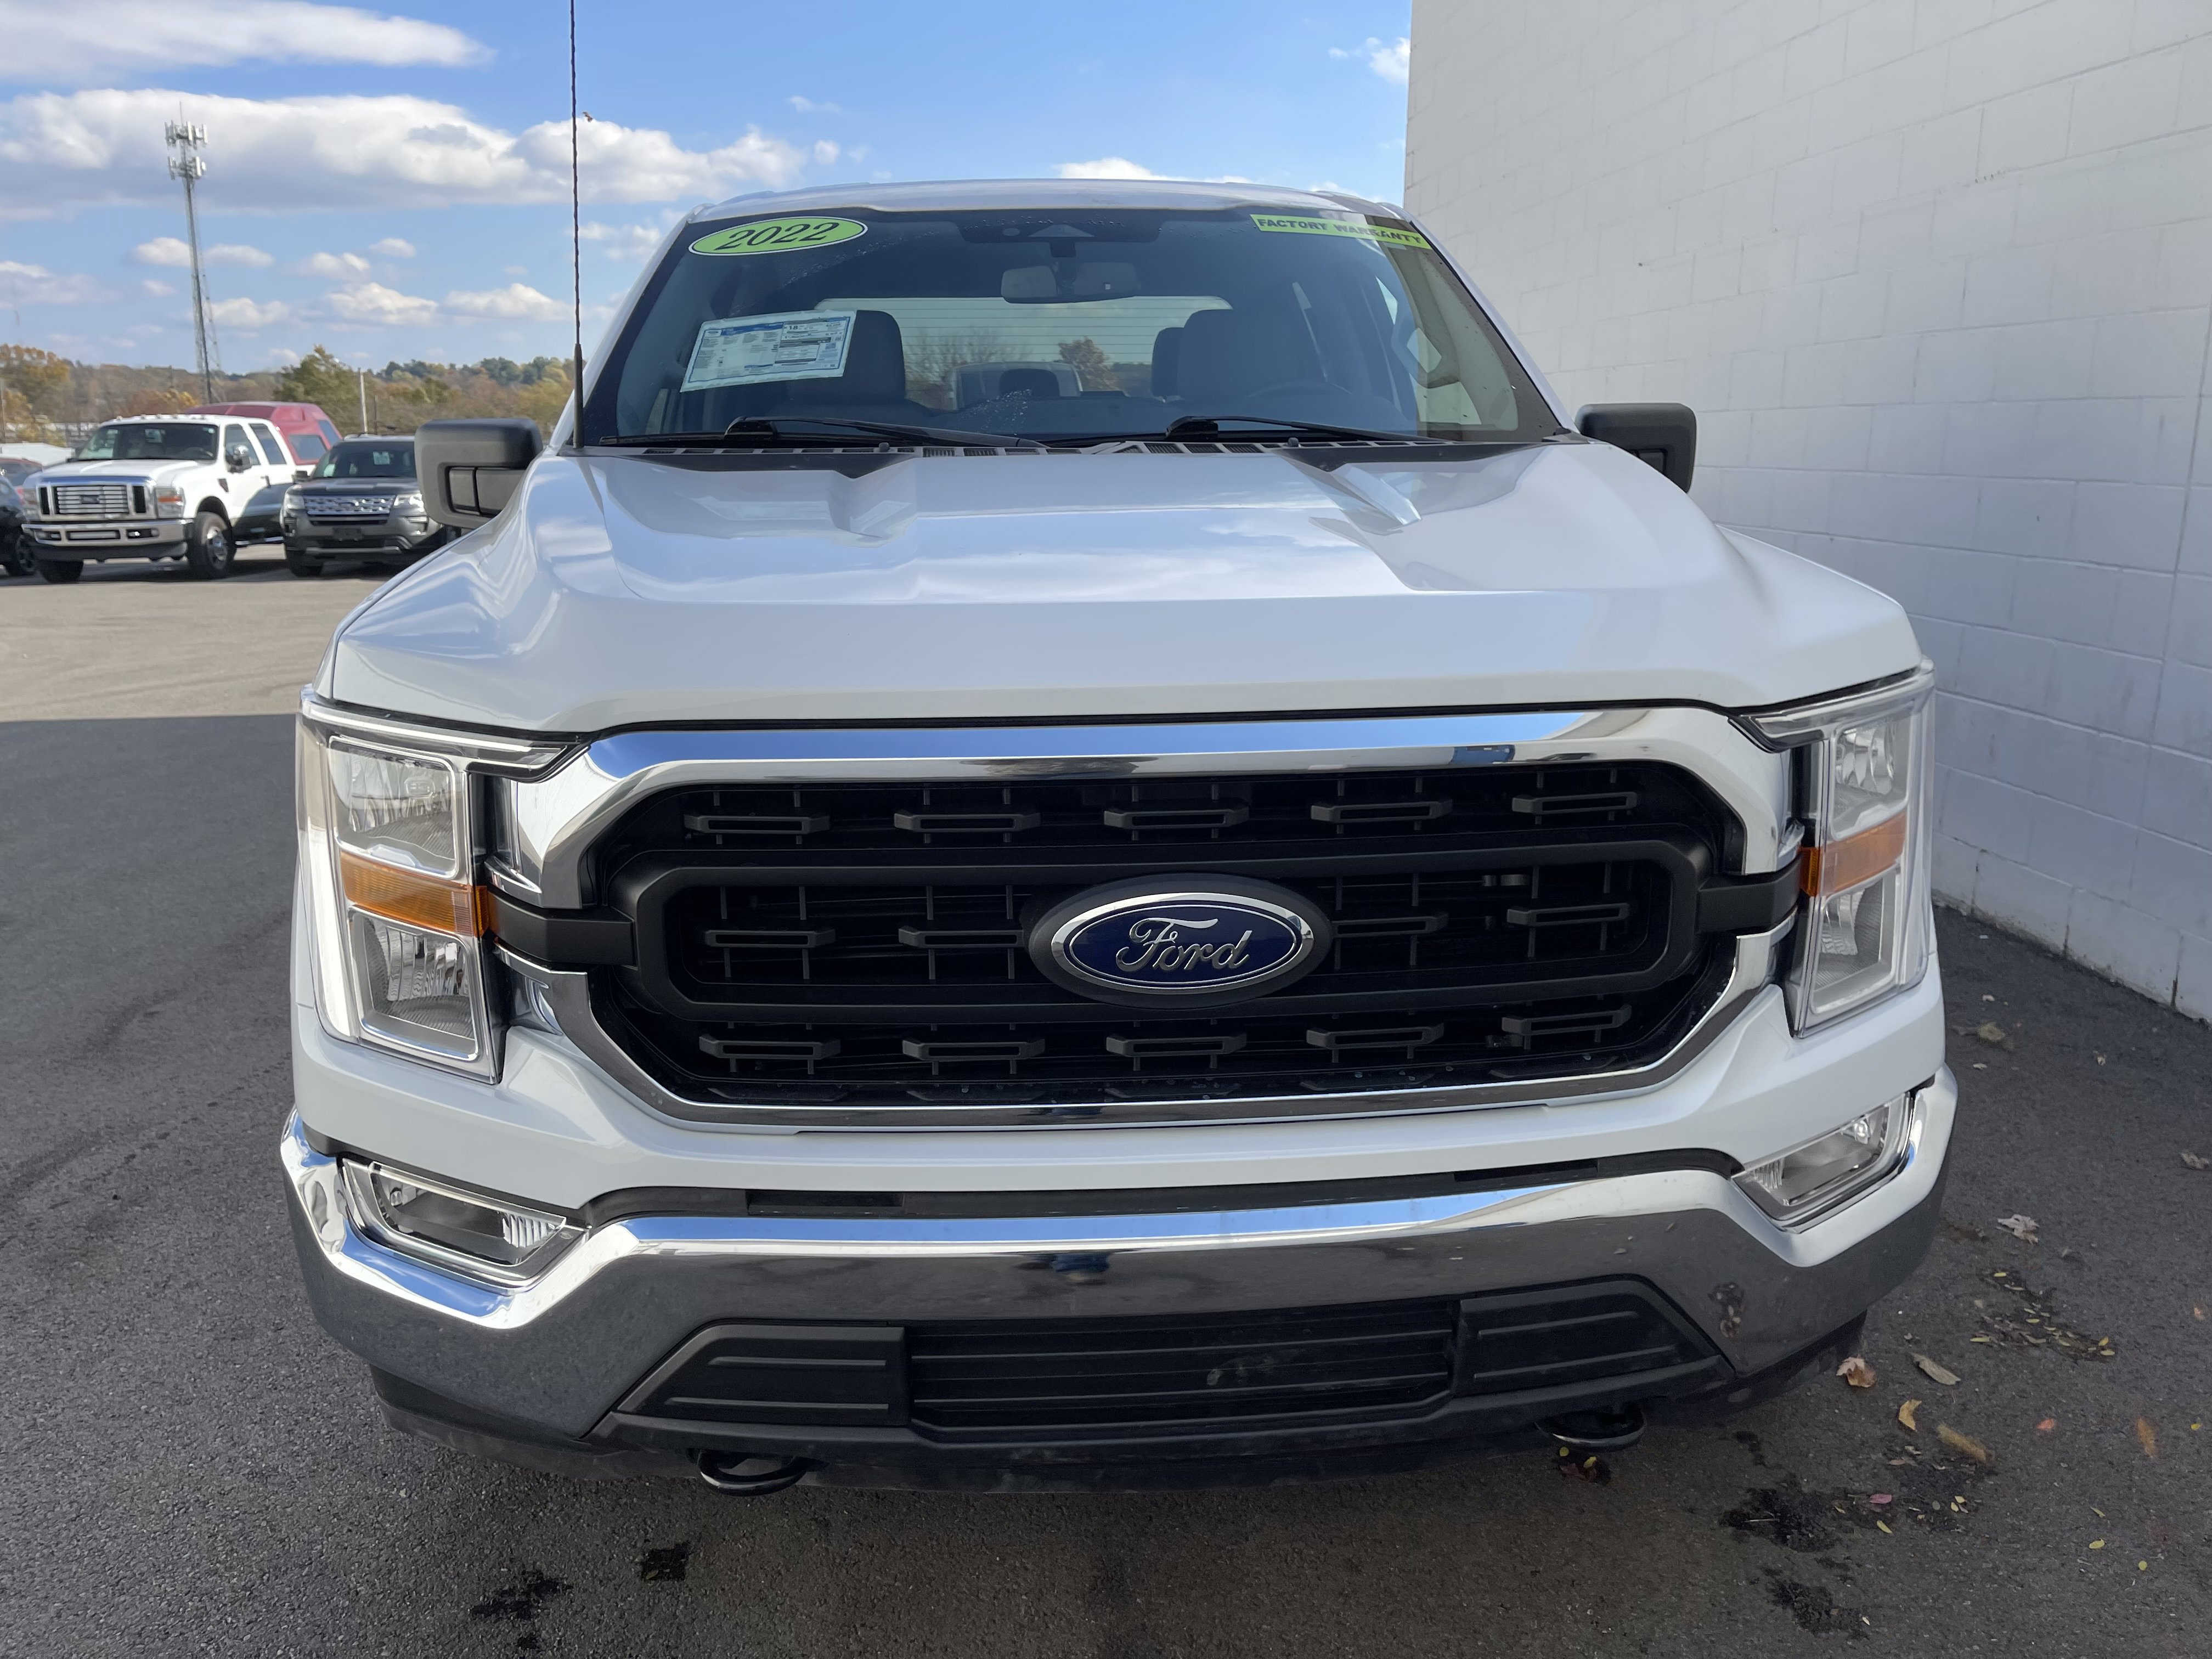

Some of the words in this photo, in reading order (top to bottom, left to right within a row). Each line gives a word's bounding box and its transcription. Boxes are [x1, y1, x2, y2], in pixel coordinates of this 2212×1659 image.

[713, 222, 839, 251] 2022
[1256, 218, 1328, 230] FACTORY
[1333, 224, 1421, 244] WARRANTY
[1115, 917, 1252, 972] Ford
